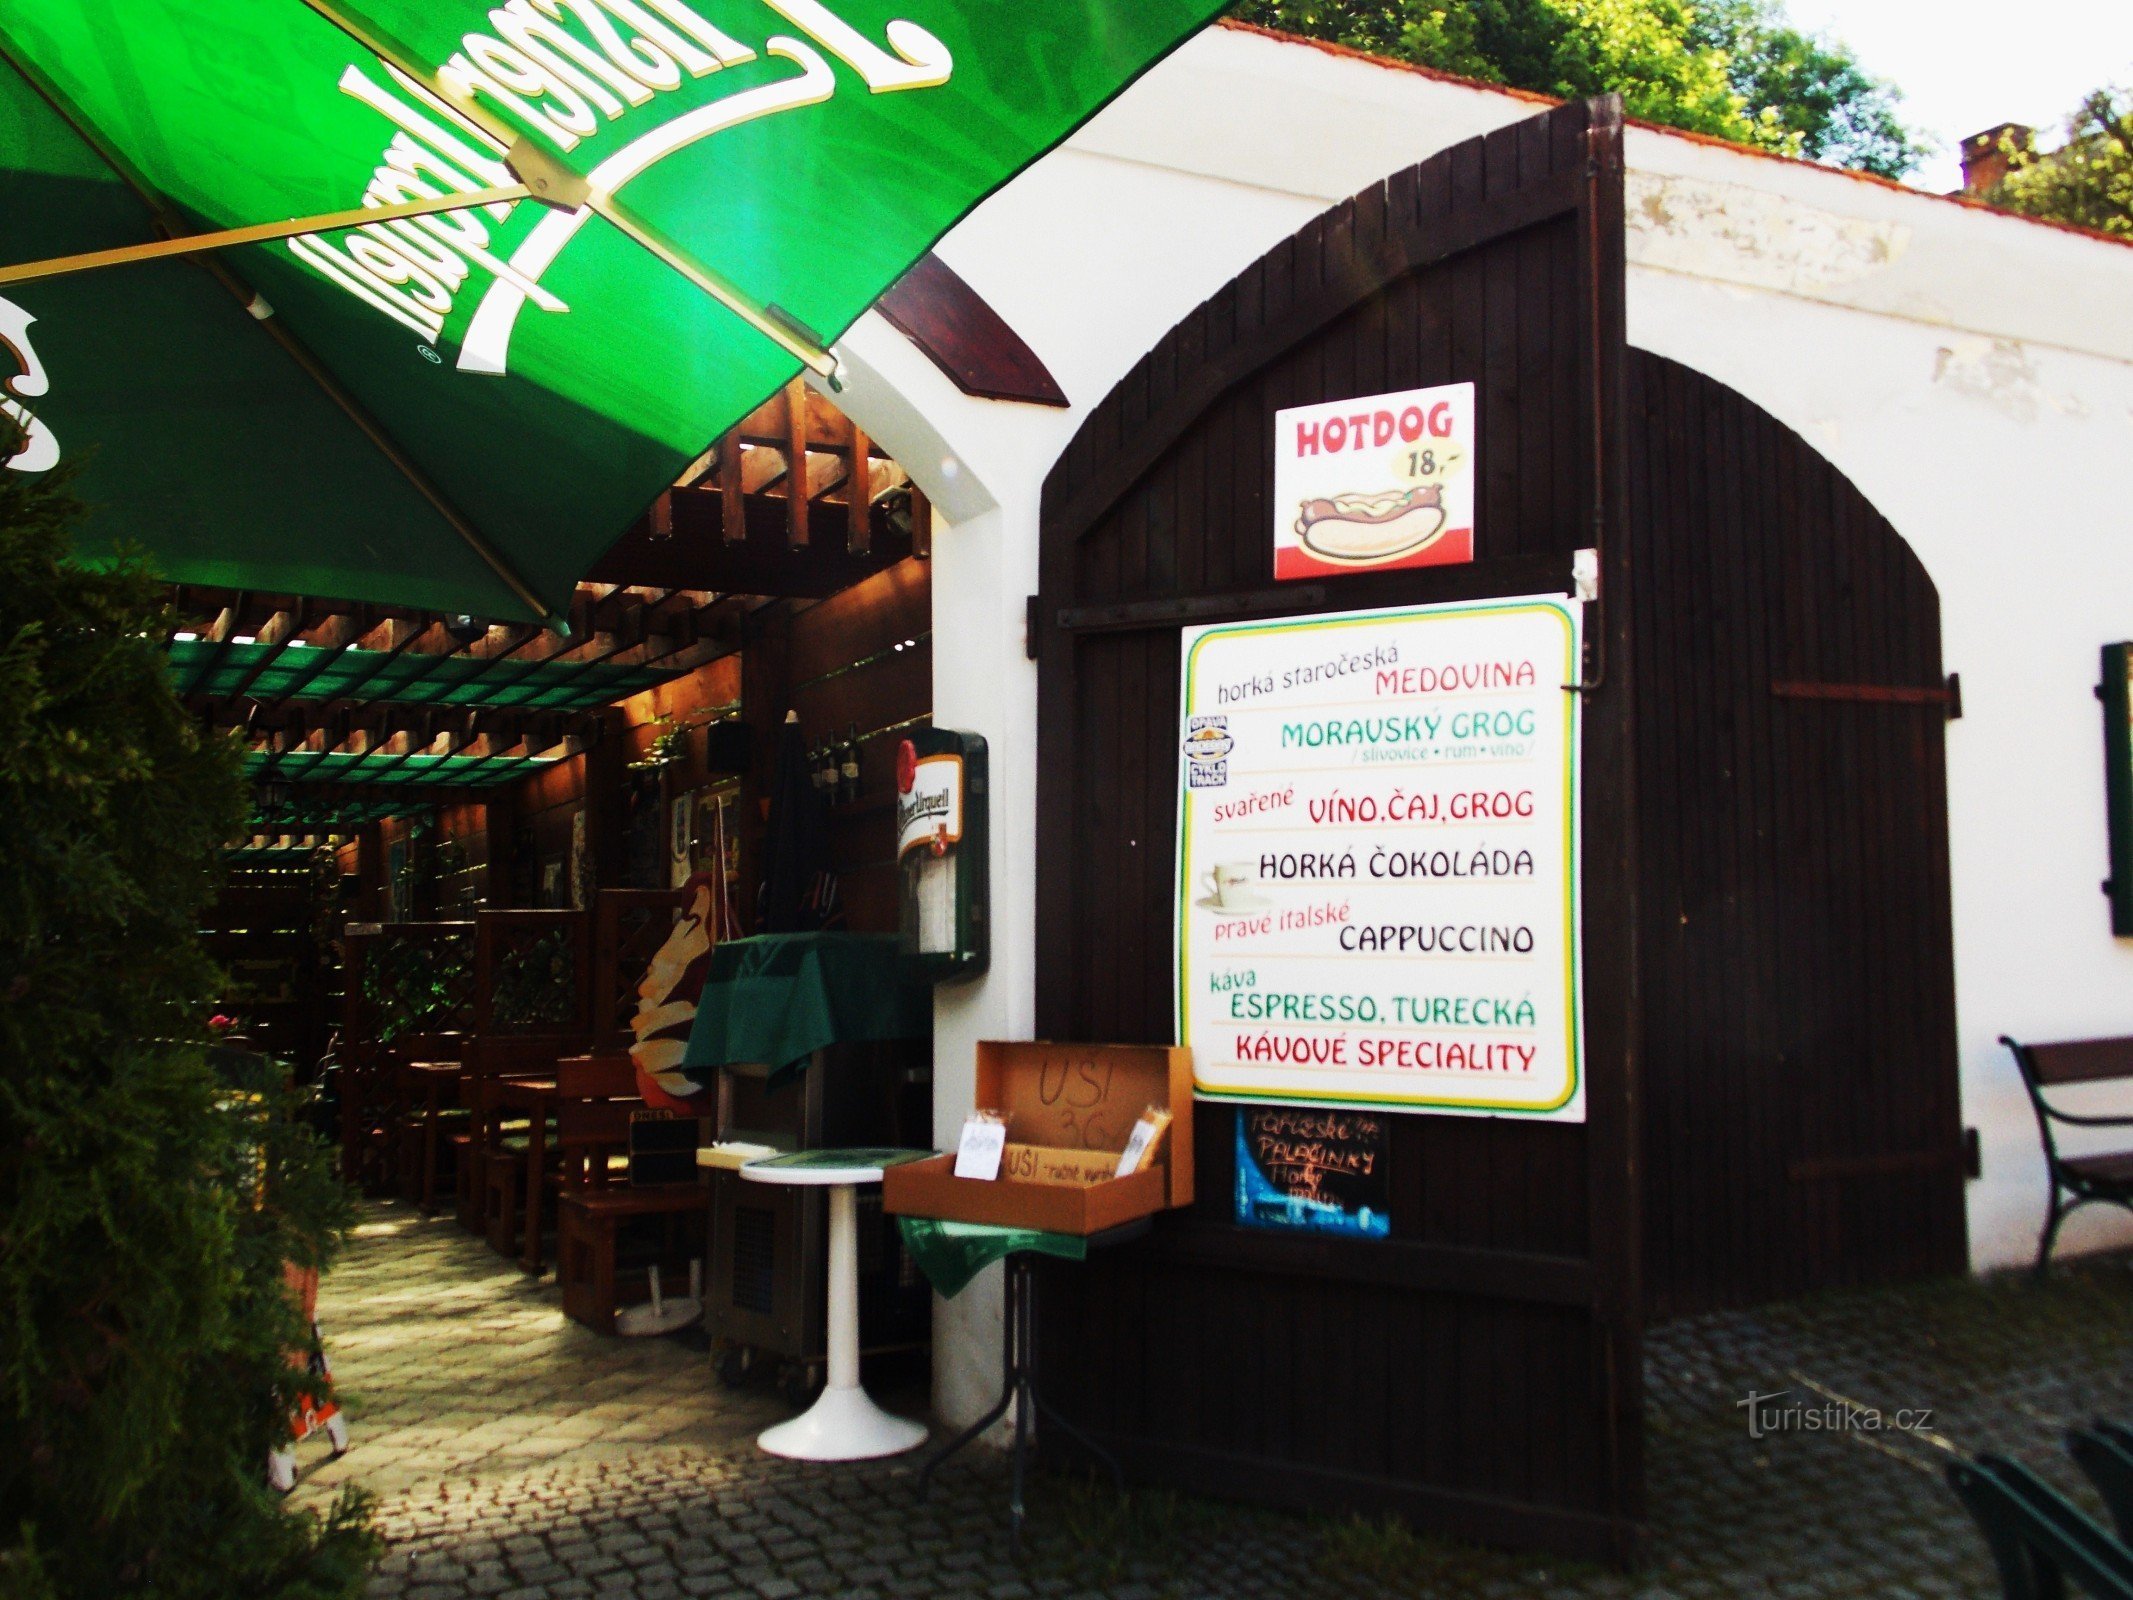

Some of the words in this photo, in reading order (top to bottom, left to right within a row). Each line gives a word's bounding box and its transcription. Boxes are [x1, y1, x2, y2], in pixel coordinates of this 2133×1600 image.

[1297, 401, 1452, 457] HOTDOG
[1218, 668, 1273, 704] horká
[1282, 643, 1399, 689] staročeská
[1375, 661, 1535, 696] MEDOVINA
[1282, 708, 1442, 748] MORAVSKÝ
[1452, 709, 1535, 738] GROG
[1214, 783, 1294, 822] svařené
[1260, 845, 1356, 878] HORKÁ
[1370, 843, 1534, 878] ČOKOLÁDA
[1215, 911, 1272, 942] pravé
[1280, 898, 1350, 932] italské
[1340, 926, 1534, 953] CAPPUCCINO
[1210, 970, 1256, 993] káva
[1393, 991, 1536, 1026] TURECKÁ
[1237, 1031, 1347, 1066] KÁVOVÉ
[1359, 1039, 1536, 1072] SPECIALITY
